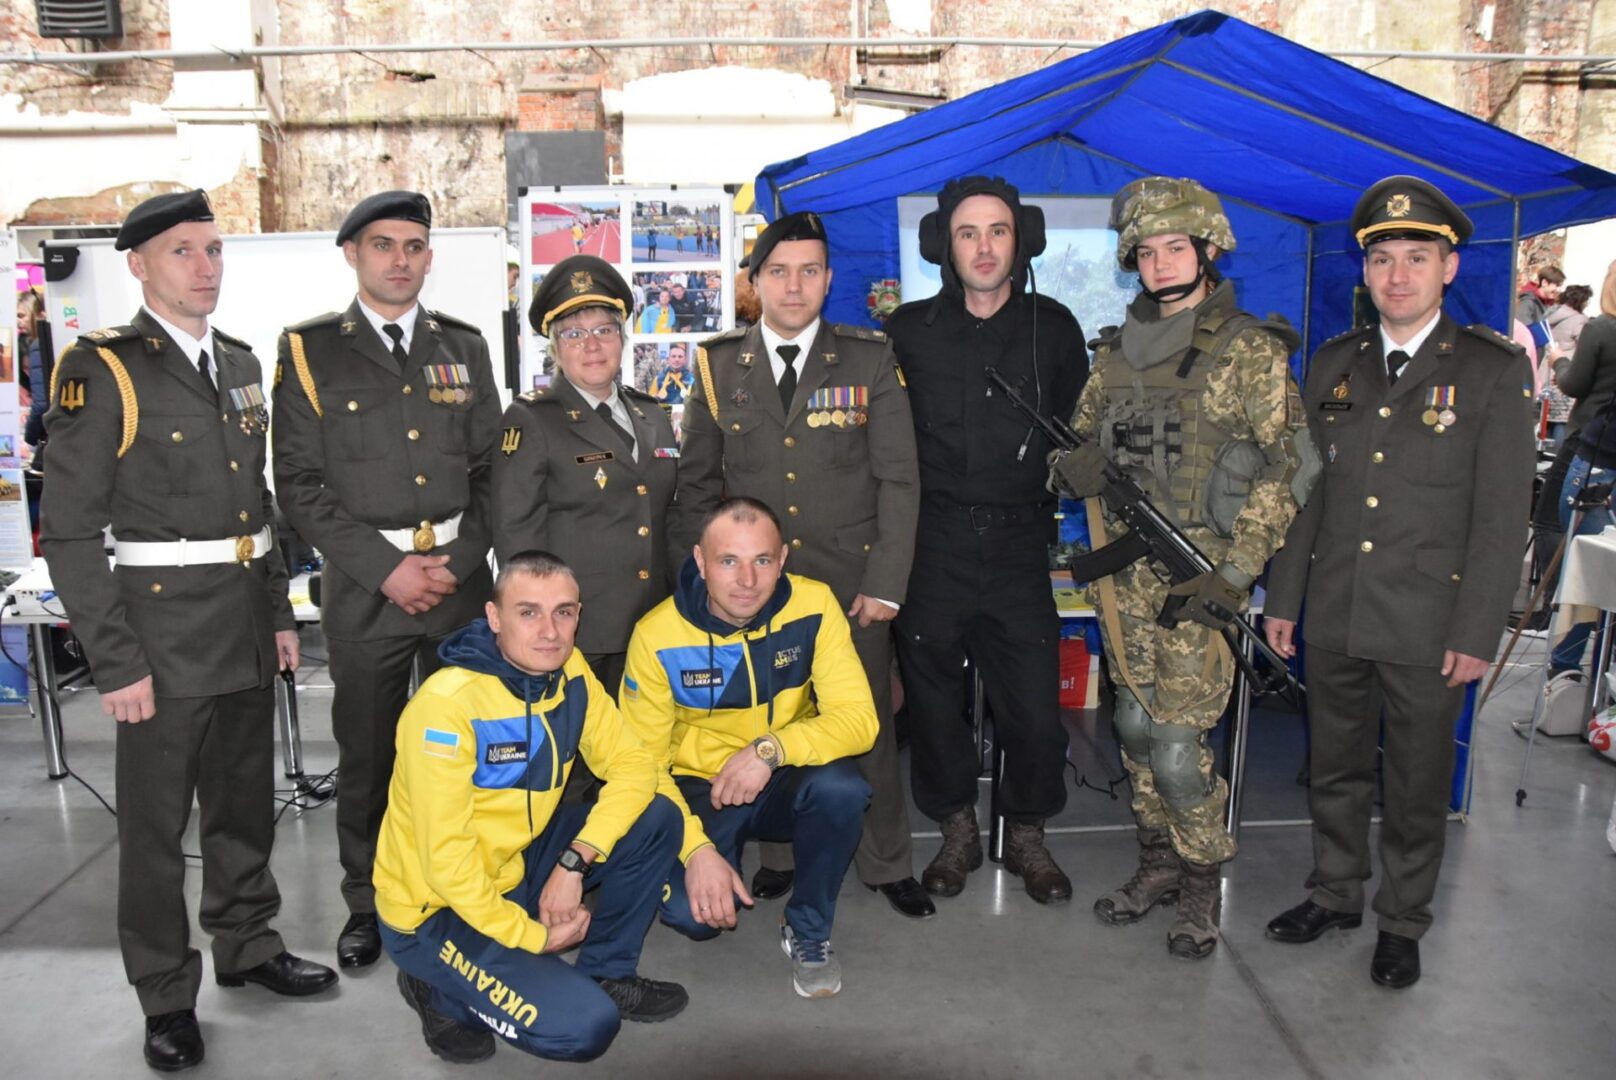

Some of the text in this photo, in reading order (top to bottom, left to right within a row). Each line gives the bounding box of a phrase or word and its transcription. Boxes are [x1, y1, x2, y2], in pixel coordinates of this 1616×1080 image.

[500, 745, 516, 754] TEAM
[500, 751, 527, 761] UKRAINE
[439, 939, 538, 1028] UKRAINE
